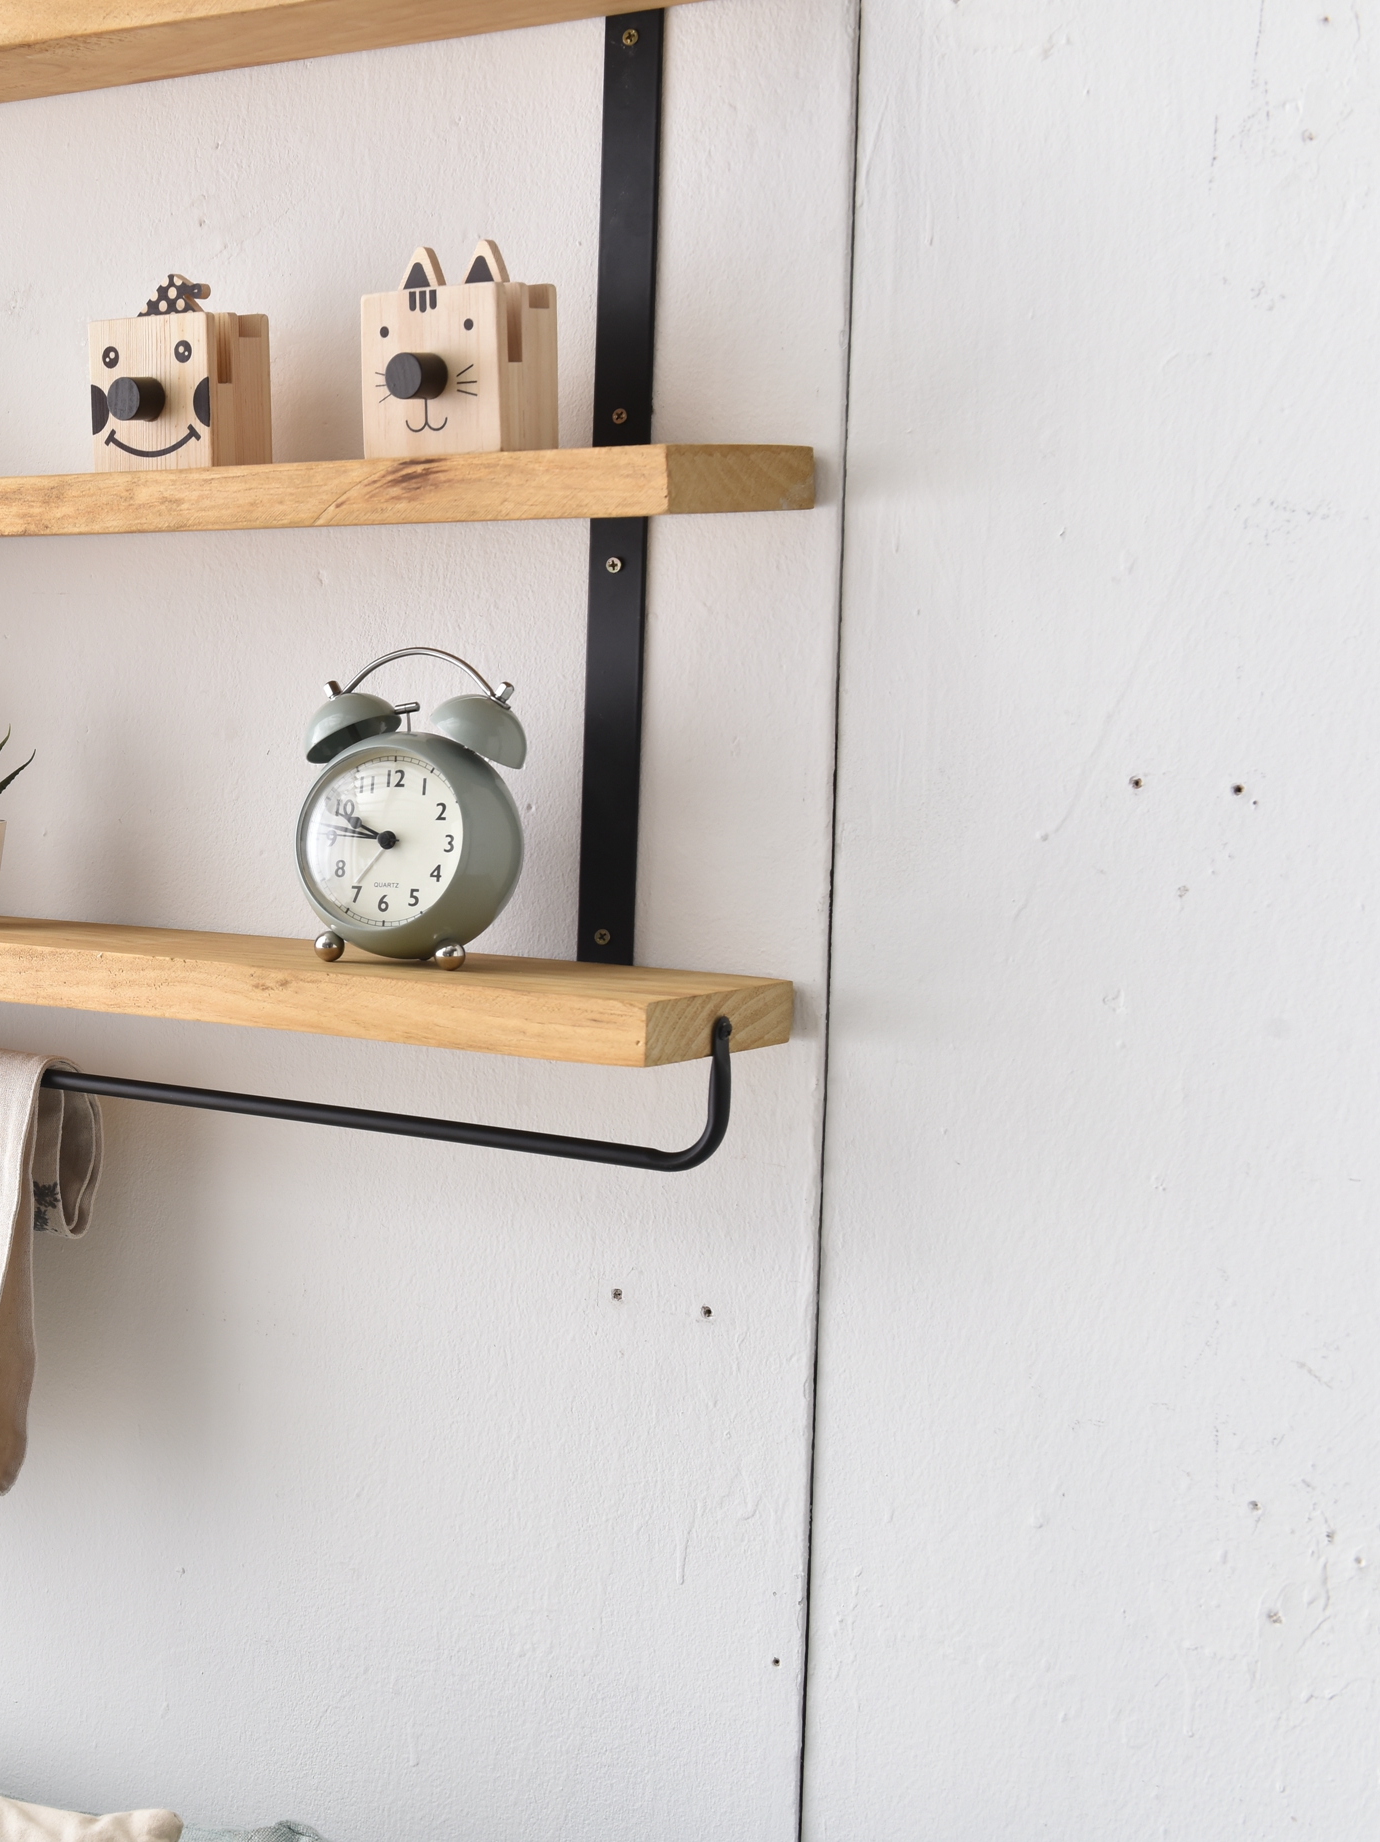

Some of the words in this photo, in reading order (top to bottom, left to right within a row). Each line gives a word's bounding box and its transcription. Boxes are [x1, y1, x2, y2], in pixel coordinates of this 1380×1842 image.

[360, 776, 375, 793] 11
[386, 770, 405, 787] 12
[422, 778, 427, 795] 1
[335, 799, 355, 817] 10
[435, 803, 447, 820] 2
[327, 830, 337, 847] 9
[444, 835, 455, 852] 3
[334, 860, 346, 877] 8
[430, 865, 442, 882] 4
[351, 886, 362, 903] 7
[408, 889, 419, 907] 5
[378, 895, 389, 912] 6
